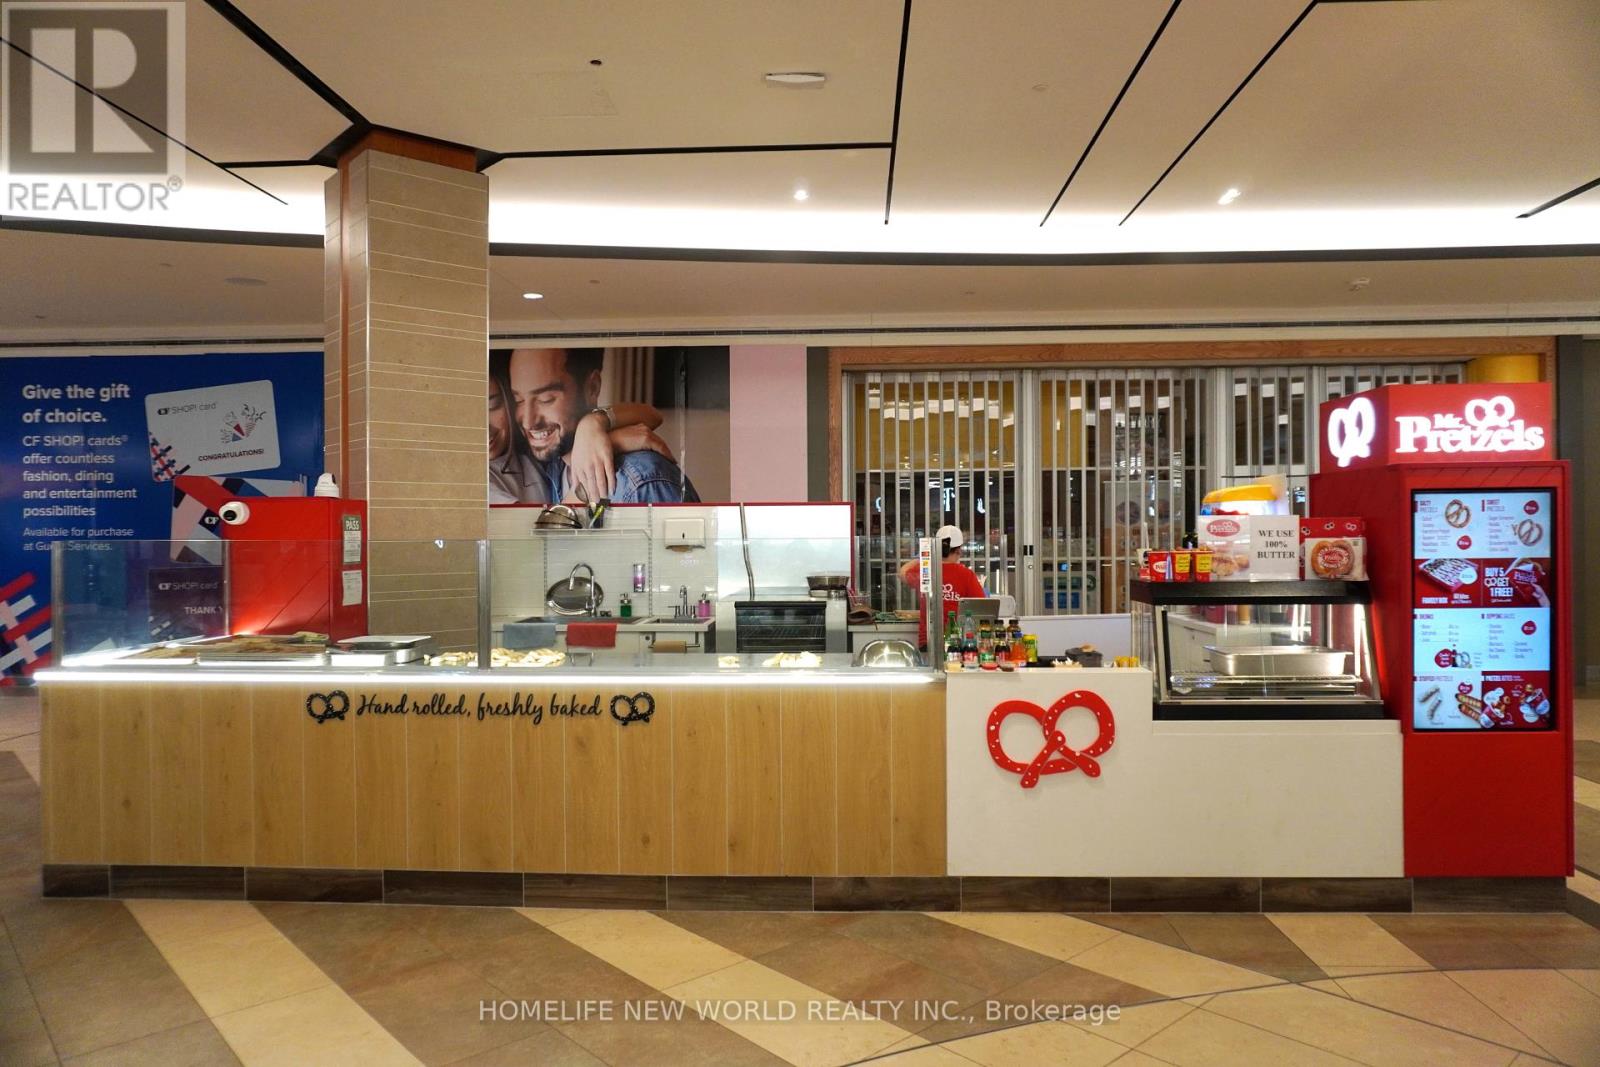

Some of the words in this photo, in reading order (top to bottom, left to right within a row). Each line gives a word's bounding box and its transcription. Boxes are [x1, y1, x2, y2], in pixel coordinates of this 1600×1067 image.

[22, 384, 62, 399] Give
[66, 384, 95, 399] the
[99, 383, 130, 402] gift
[22, 409, 42, 423] of
[44, 408, 107, 423] choice.
[1395, 416, 1545, 453] Pretzels
[22, 435, 41, 447] CF
[43, 435, 85, 447] SHOP!
[22, 452, 53, 465] offer
[54, 452, 116, 465] countless
[198, 448, 265, 462] CONGRATULATIONS!
[22, 470, 72, 483] fashion,
[74, 470, 115, 484] dining
[23, 488, 47, 499] and
[49, 487, 138, 499] entertainment
[23, 505, 97, 518] possibilities
[345, 520, 360, 530] PASS
[23, 527, 69, 537] Available
[71, 527, 85, 537] for
[87, 527, 134, 538] purchase
[1259, 529, 1274, 537] WE
[1276, 529, 1295, 537] USE
[23, 543, 34, 551] at
[67, 541, 113, 551] Services.
[1265, 540, 1288, 549] 100%
[1257, 551, 1296, 559] BUTTER
[184, 606, 217, 614] THANK
[356, 693, 409, 716] Hand
[412, 692, 471, 717] rolled,
[477, 692, 543, 725] freshly
[550, 692, 603, 717] baked
